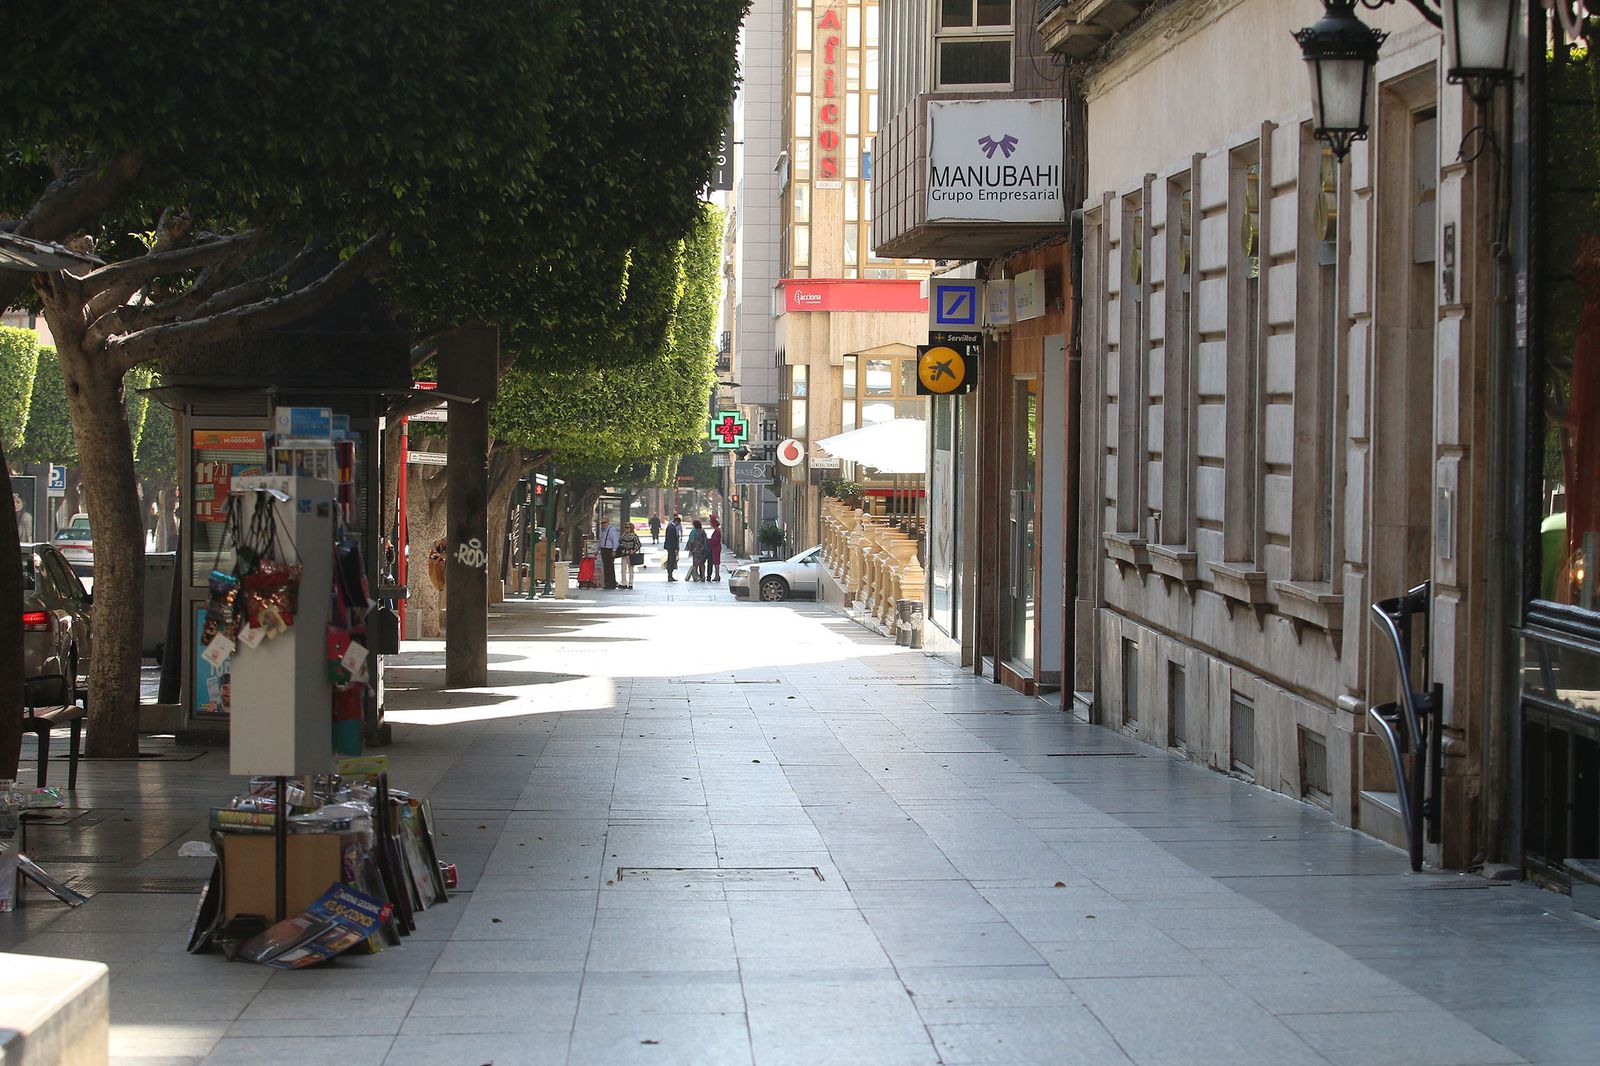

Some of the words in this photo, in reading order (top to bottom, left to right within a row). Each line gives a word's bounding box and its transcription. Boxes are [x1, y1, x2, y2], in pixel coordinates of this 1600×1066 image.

[931, 165, 1059, 187] MANUBAHI
[931, 189, 974, 203] Grupo
[978, 188, 1059, 202] Empresarial
[947, 334, 977, 342] ServiRed
[48, 466, 60, 487] P
